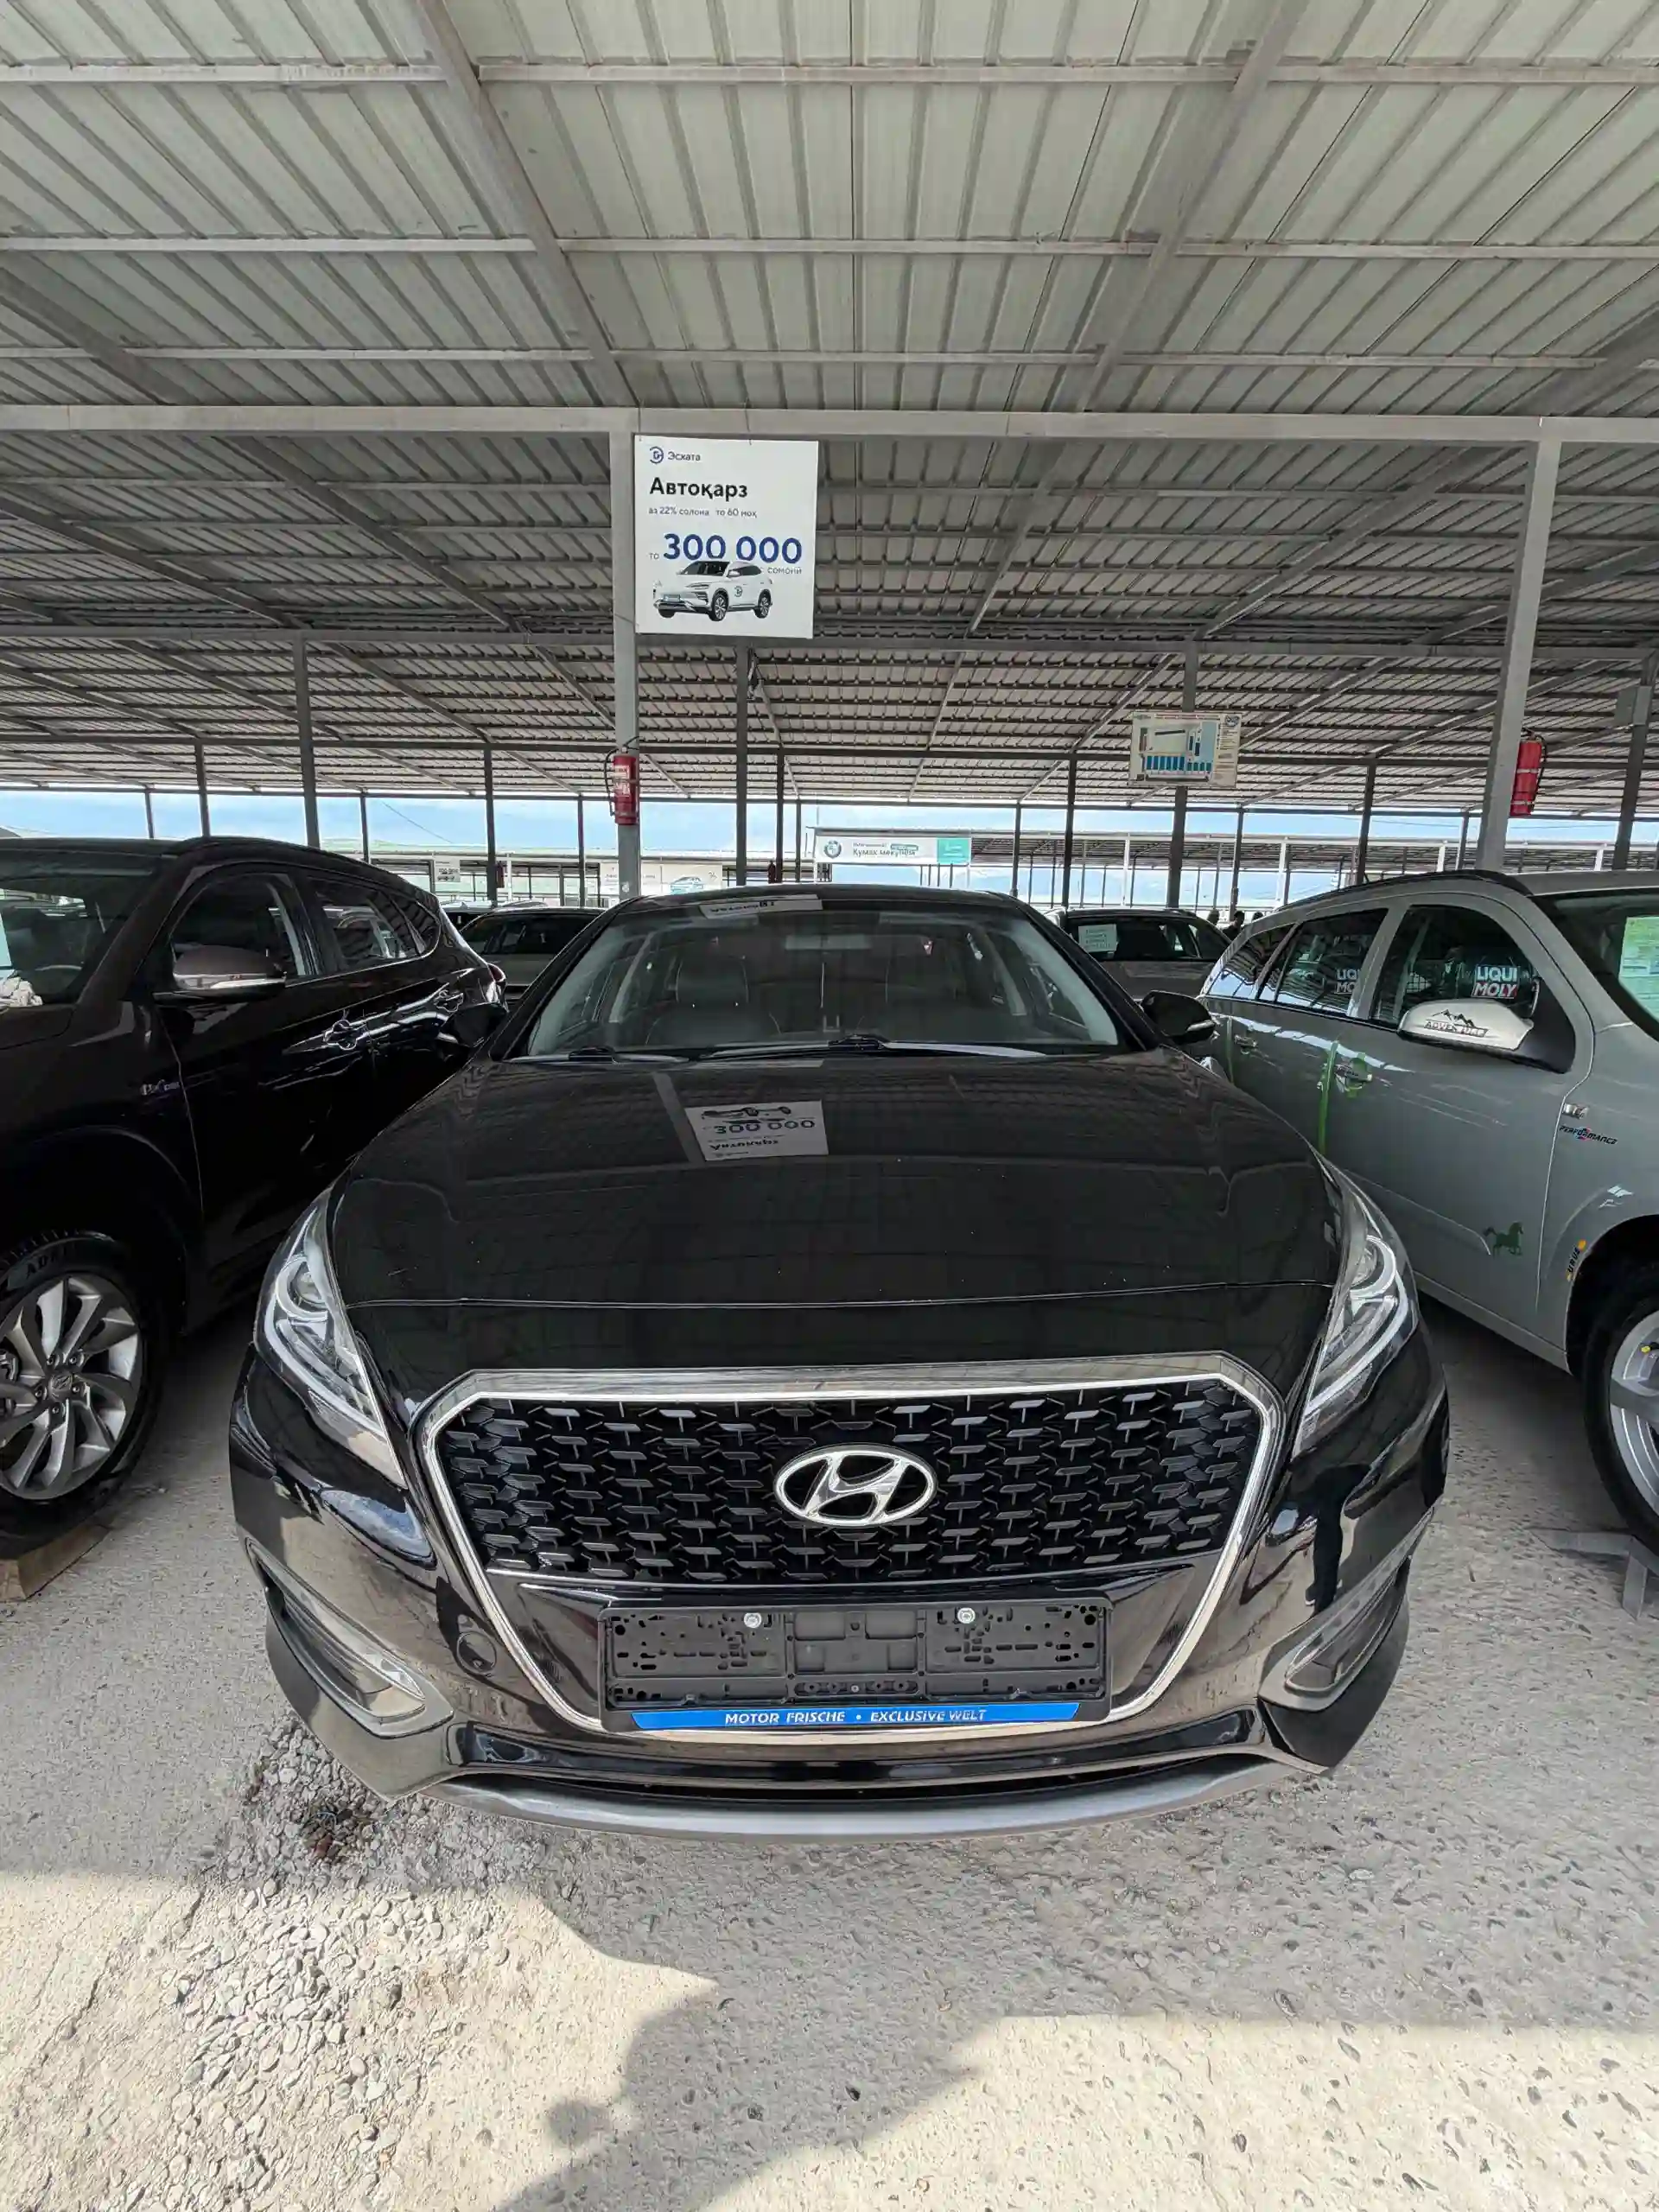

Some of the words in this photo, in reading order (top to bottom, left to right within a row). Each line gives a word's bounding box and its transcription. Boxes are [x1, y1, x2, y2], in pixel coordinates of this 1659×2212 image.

[668, 451, 701, 461] Эсхата
[650, 477, 747, 501] Автоқарз
[659, 506, 677, 515] 22%
[679, 507, 709, 516] солона
[664, 533, 726, 560] 300
[736, 536, 803, 564] 000
[1337, 969, 1359, 981] LIQ
[1477, 966, 1518, 982] LIQUI
[1335, 982, 1354, 993] MO
[1473, 982, 1517, 997] MOLY
[725, 1713, 780, 1725] MOTOR
[786, 1711, 846, 1723] FRISCHE
[870, 1710, 945, 1722] EXCLUSIVE
[950, 1708, 988, 1721] WELT
